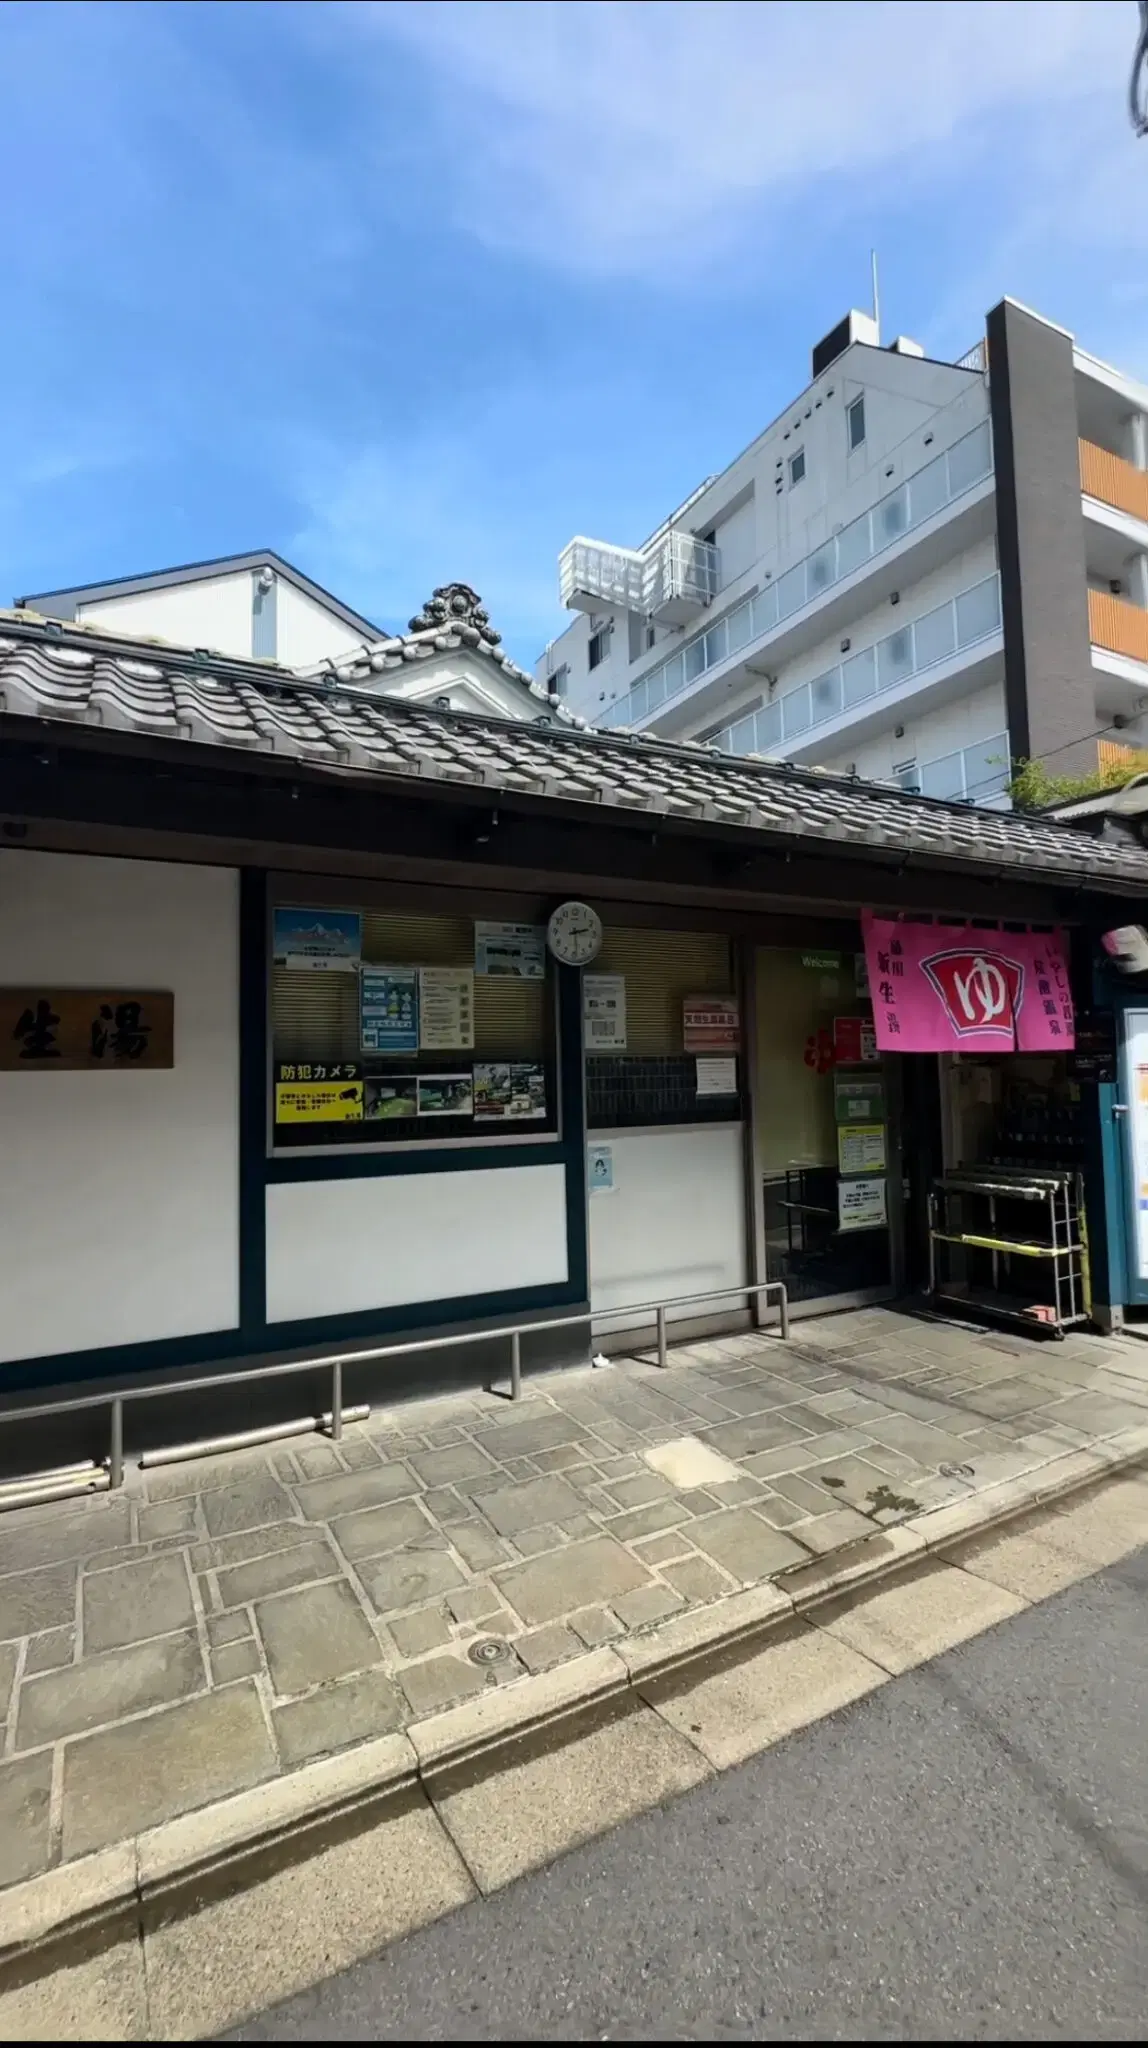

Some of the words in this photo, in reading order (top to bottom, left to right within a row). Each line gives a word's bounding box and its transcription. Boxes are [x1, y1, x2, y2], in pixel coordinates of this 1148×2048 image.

[800, 955, 840, 969] Welcome
[954, 955, 1006, 1026] ゆ
[11, 999, 153, 1060] 生湯
[279, 1063, 357, 1080] 防犯カメラ
